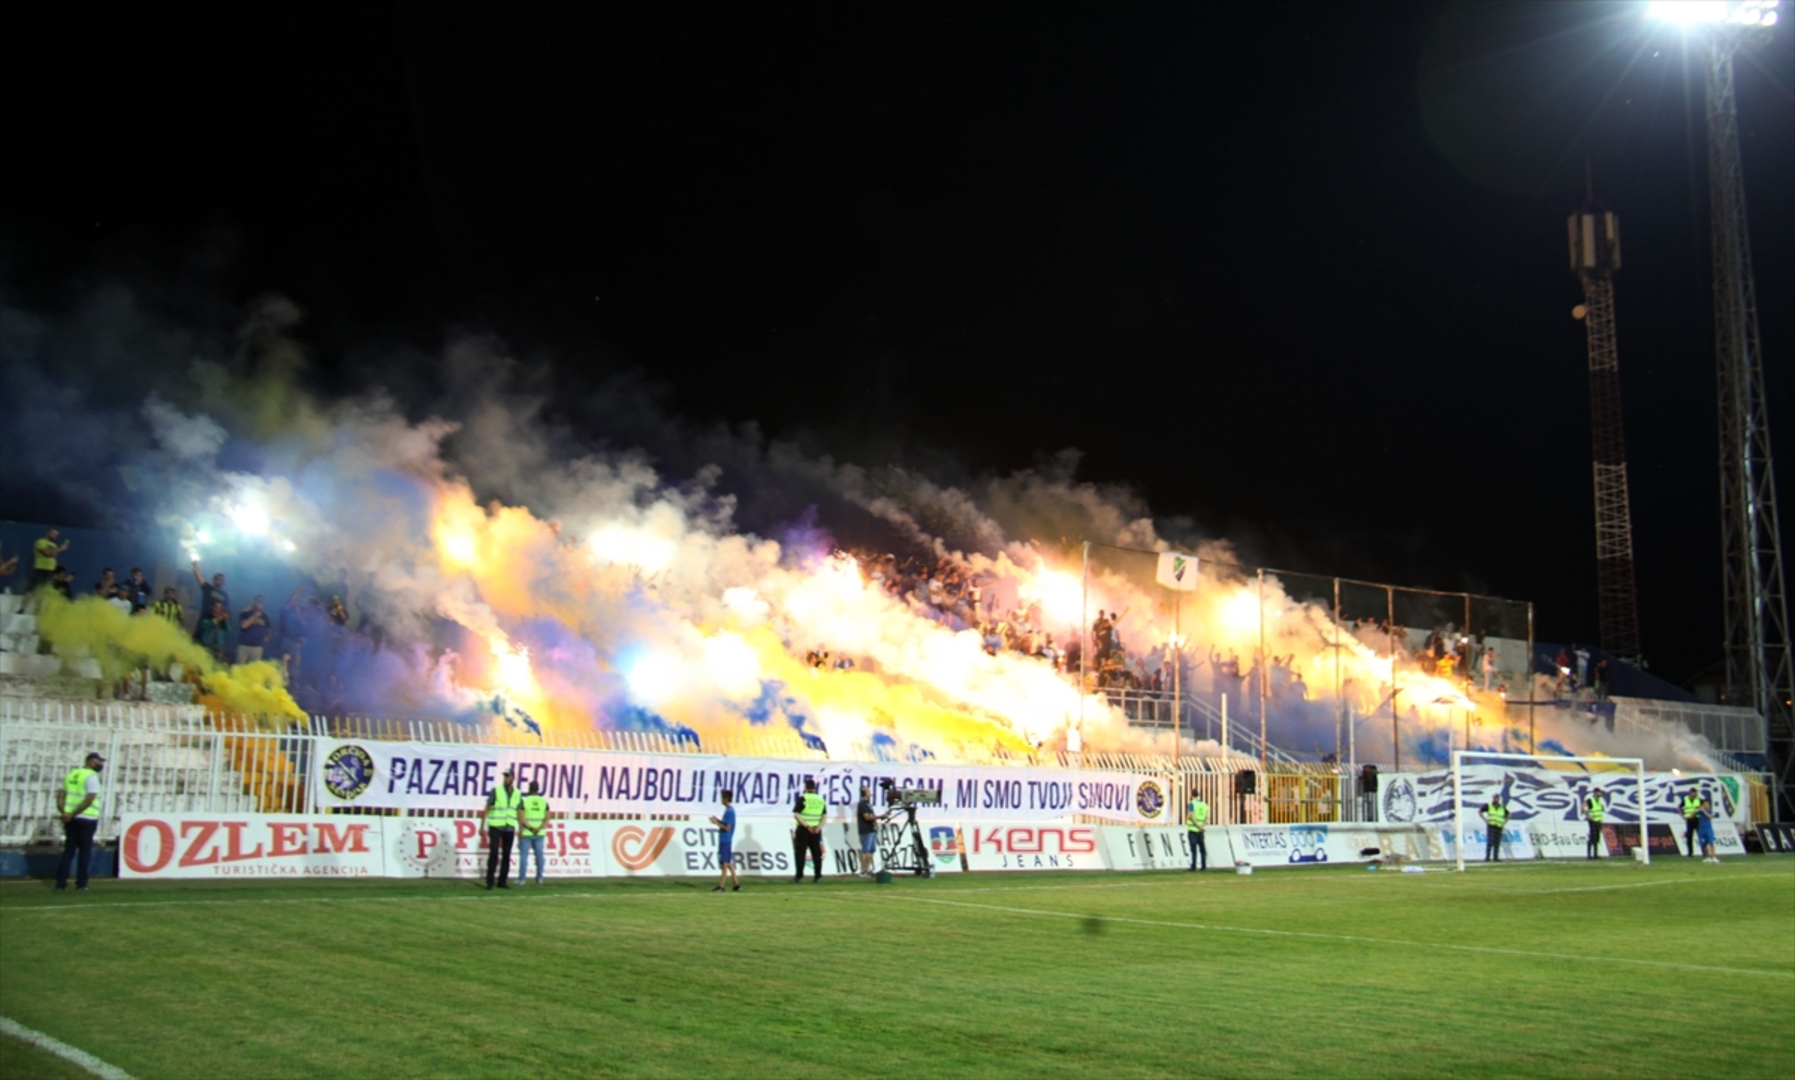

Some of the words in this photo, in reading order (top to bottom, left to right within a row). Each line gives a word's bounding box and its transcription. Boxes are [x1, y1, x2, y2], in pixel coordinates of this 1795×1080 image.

[388, 757, 497, 796] PAZARE
[507, 762, 589, 804] EDINI,
[598, 766, 706, 803] NAJBOLJI
[713, 770, 780, 805] NIKAD
[956, 779, 978, 809] MI
[983, 780, 1021, 809] SMO
[1027, 781, 1073, 810] TVOJI
[1078, 782, 1131, 811] SINOVI
[123, 819, 369, 874] OZLEM
[683, 827, 721, 848] CIT
[1127, 832, 1190, 858] FENE
[1242, 831, 1288, 849] INTERTAS
[213, 863, 297, 875] TURISTIČKA
[303, 864, 368, 876] AGENCIJA
[685, 851, 788, 870] EXRESS
[1003, 853, 1073, 868] JEANS
